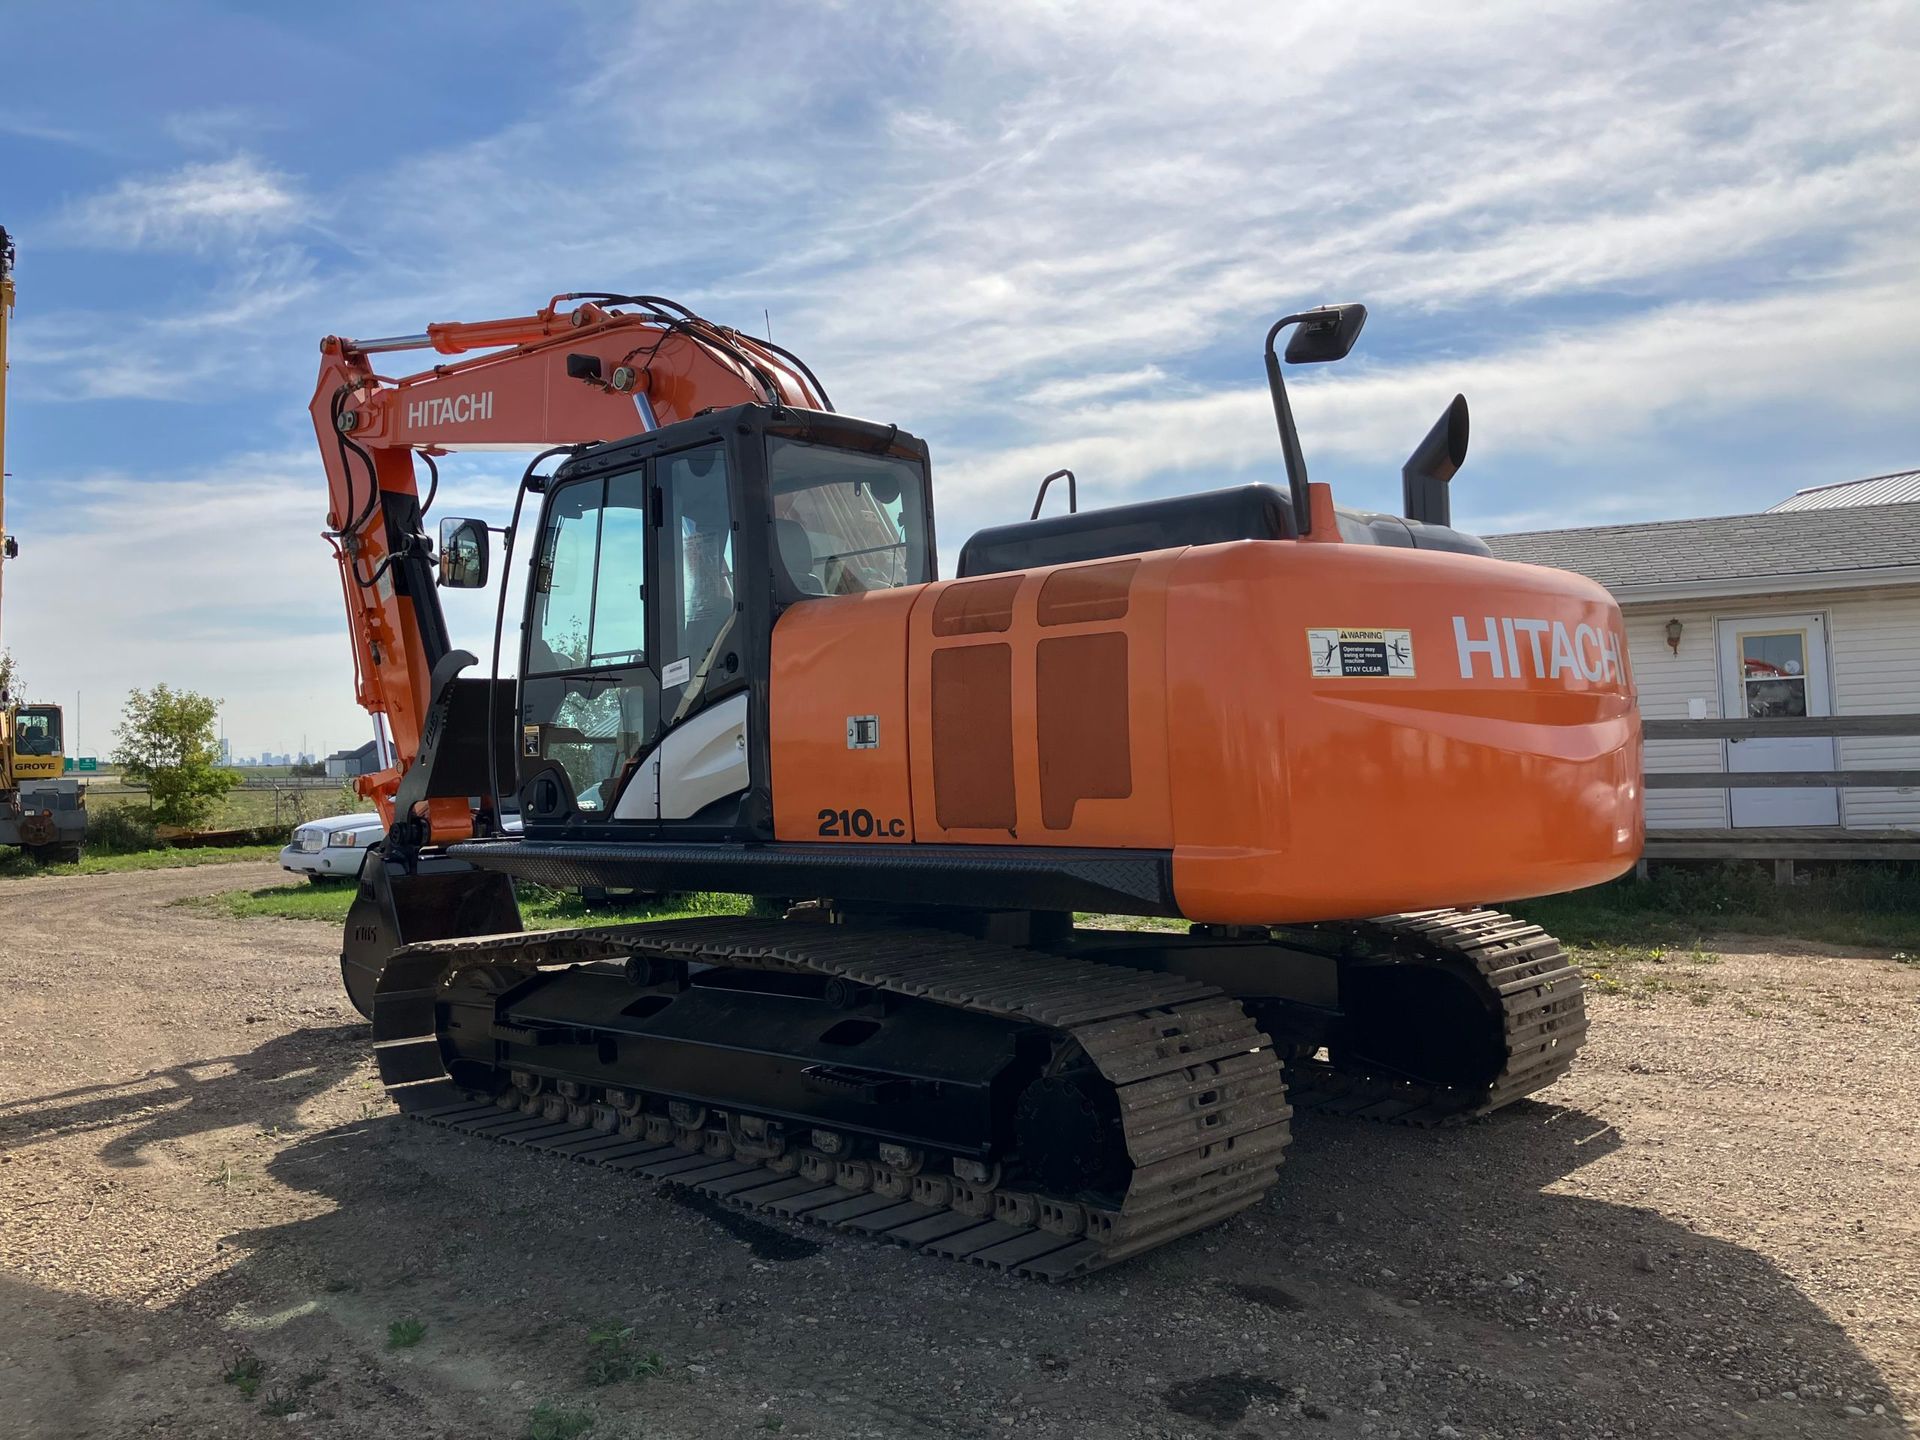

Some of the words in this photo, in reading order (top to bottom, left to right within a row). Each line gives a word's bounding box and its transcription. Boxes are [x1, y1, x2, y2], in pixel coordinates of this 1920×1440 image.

[408, 391, 493, 428] HITACHI
[1347, 631, 1383, 640] WARNING
[1452, 616, 1627, 686] HITACHI
